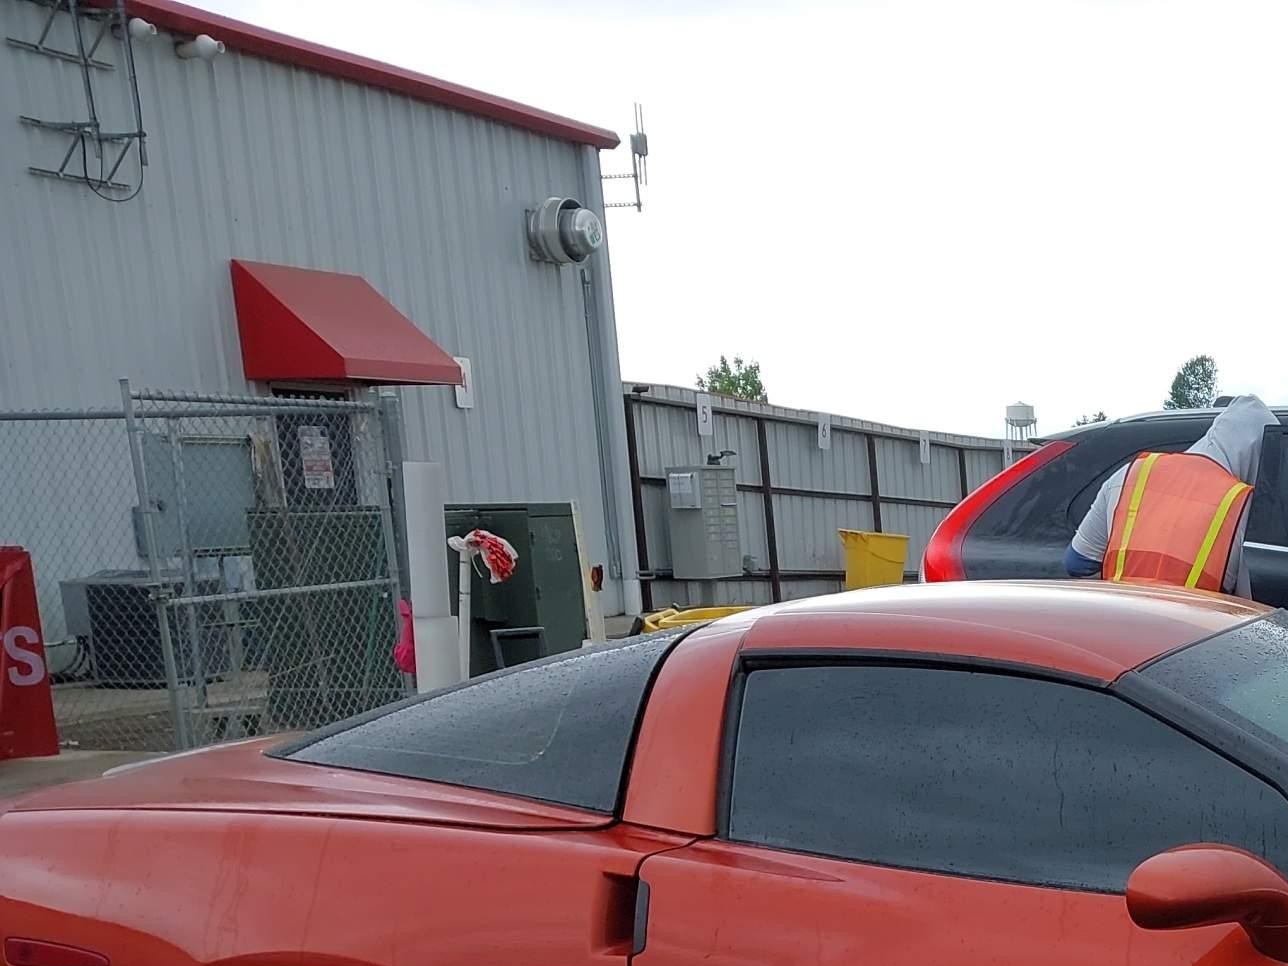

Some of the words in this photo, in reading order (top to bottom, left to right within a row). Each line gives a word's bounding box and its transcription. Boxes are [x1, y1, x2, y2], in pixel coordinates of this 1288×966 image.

[702, 405, 708, 424] 5
[821, 422, 827, 439] 6
[922, 439, 927, 453] 7
[0, 626, 45, 686] S
